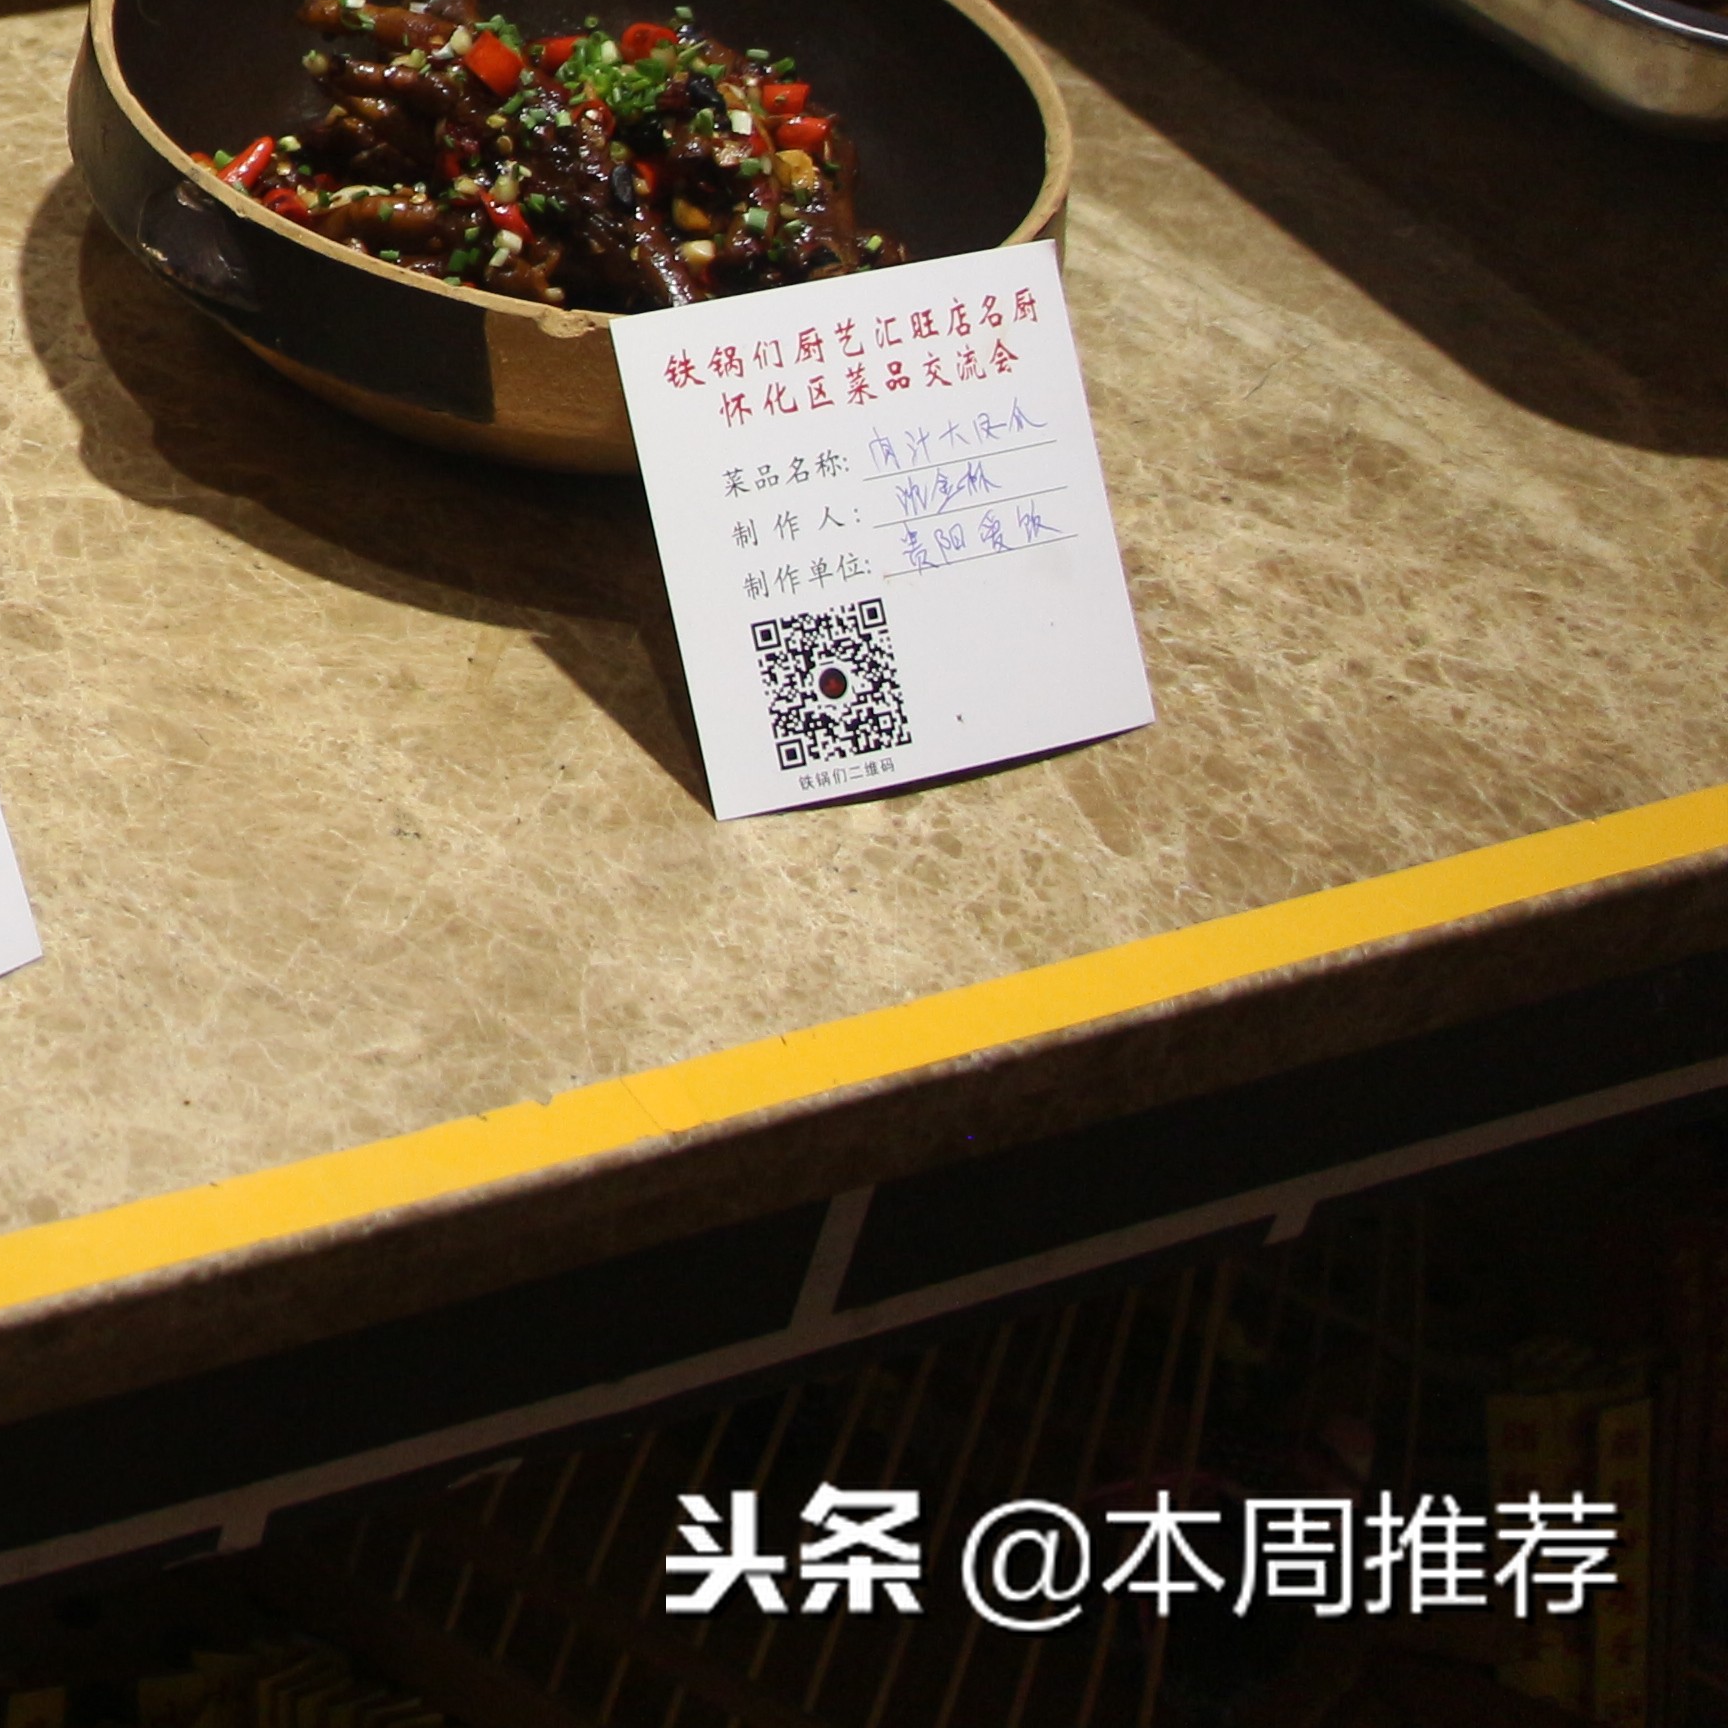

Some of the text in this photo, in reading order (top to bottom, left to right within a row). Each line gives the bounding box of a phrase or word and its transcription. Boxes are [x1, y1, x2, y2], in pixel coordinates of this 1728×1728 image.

[663, 287, 1037, 388] 铁锅们厨艺汇旺店名厨
[719, 338, 1018, 427] 怀化区菜品交流会
[799, 758, 895, 790] 铁锅们二维码
